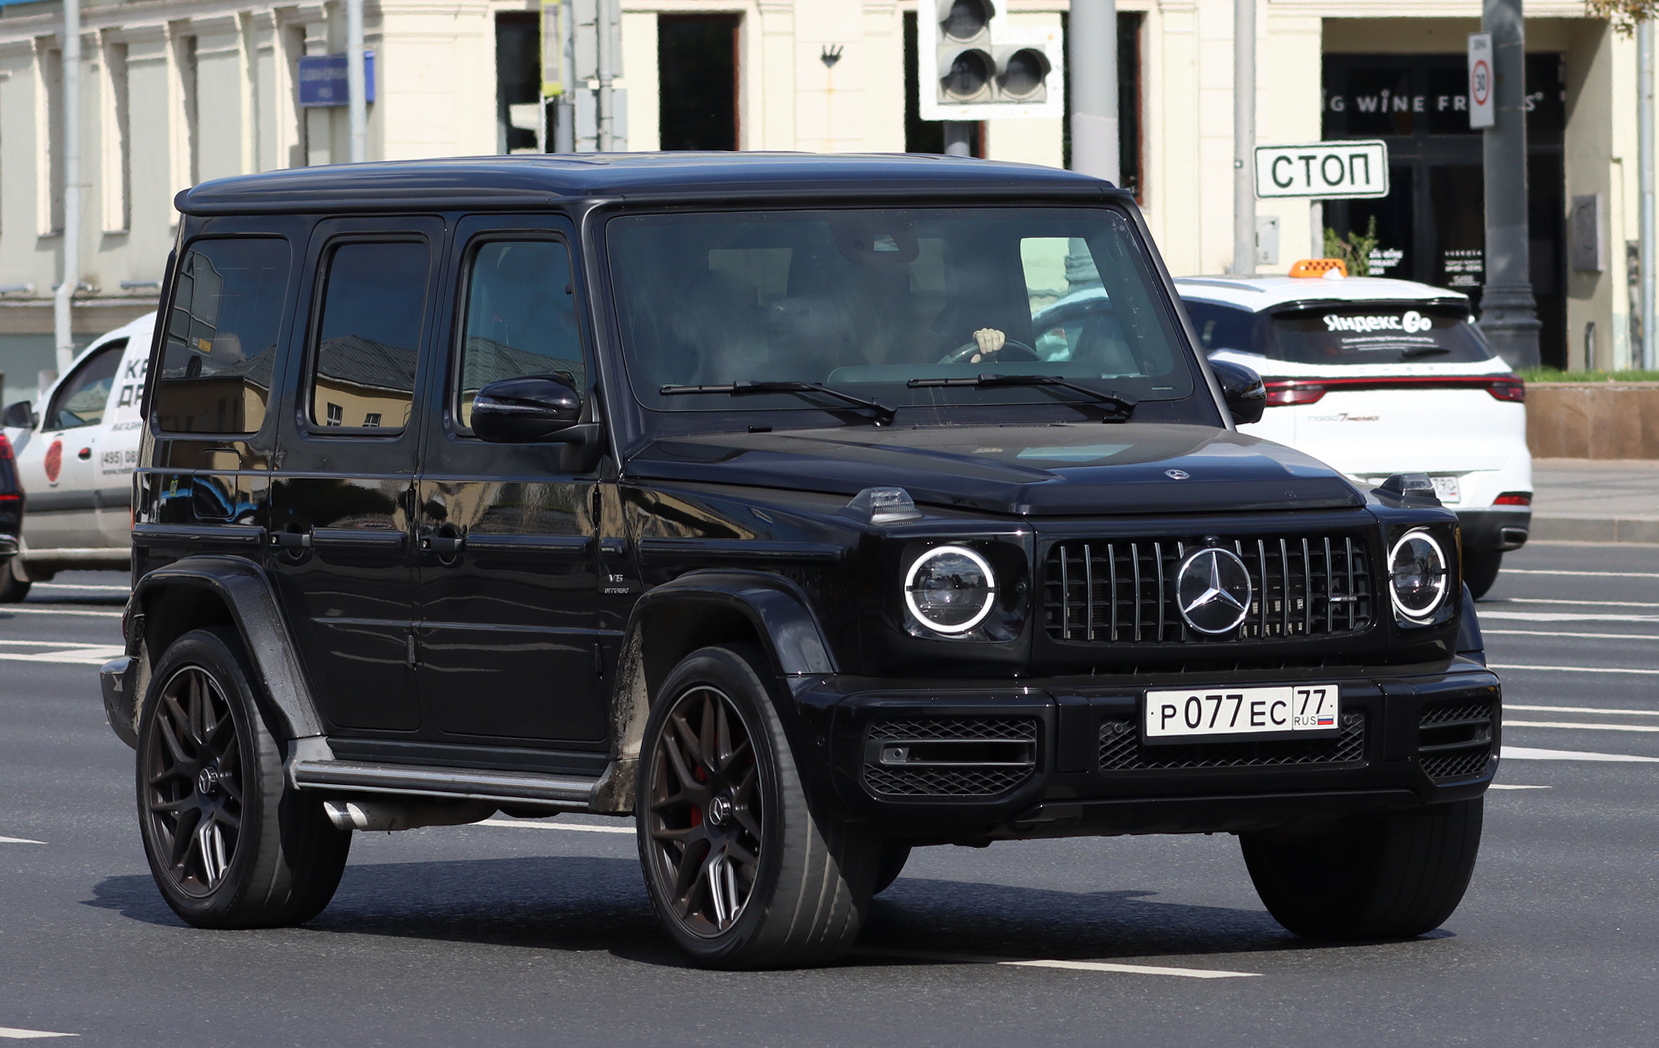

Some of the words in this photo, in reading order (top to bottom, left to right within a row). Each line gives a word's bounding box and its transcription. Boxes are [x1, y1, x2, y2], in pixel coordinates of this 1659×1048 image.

[1476, 73, 1486, 92] 30
[1271, 153, 1371, 189] СТОП
[1323, 314, 1403, 332] Яндекс
[1402, 311, 1433, 333] Go
[1297, 689, 1327, 715] 77
[1294, 716, 1317, 726] RUS
